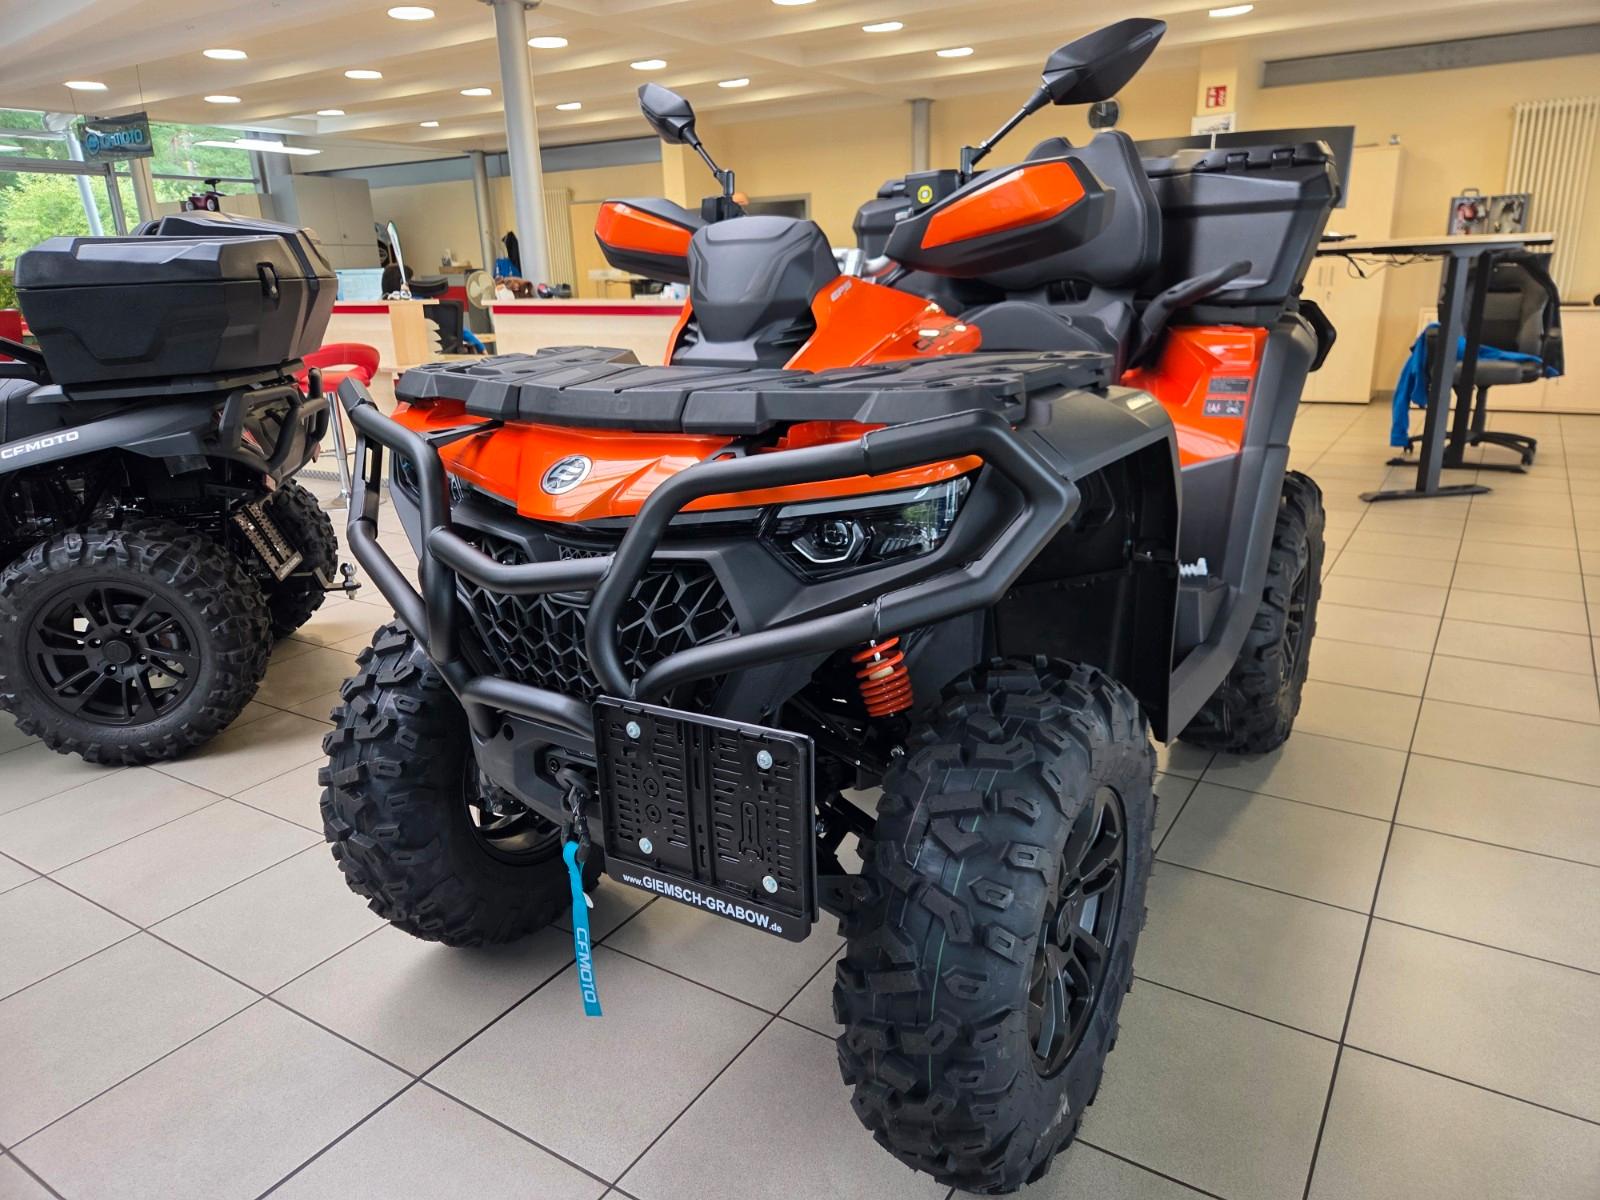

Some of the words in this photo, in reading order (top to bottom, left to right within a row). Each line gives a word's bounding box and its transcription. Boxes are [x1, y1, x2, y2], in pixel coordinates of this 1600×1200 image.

[1, 431, 79, 459] CFMOTO
[622, 873, 783, 933] www.GIEMSCH-GRABOW.de
[576, 927, 597, 1004] CFMOTO
